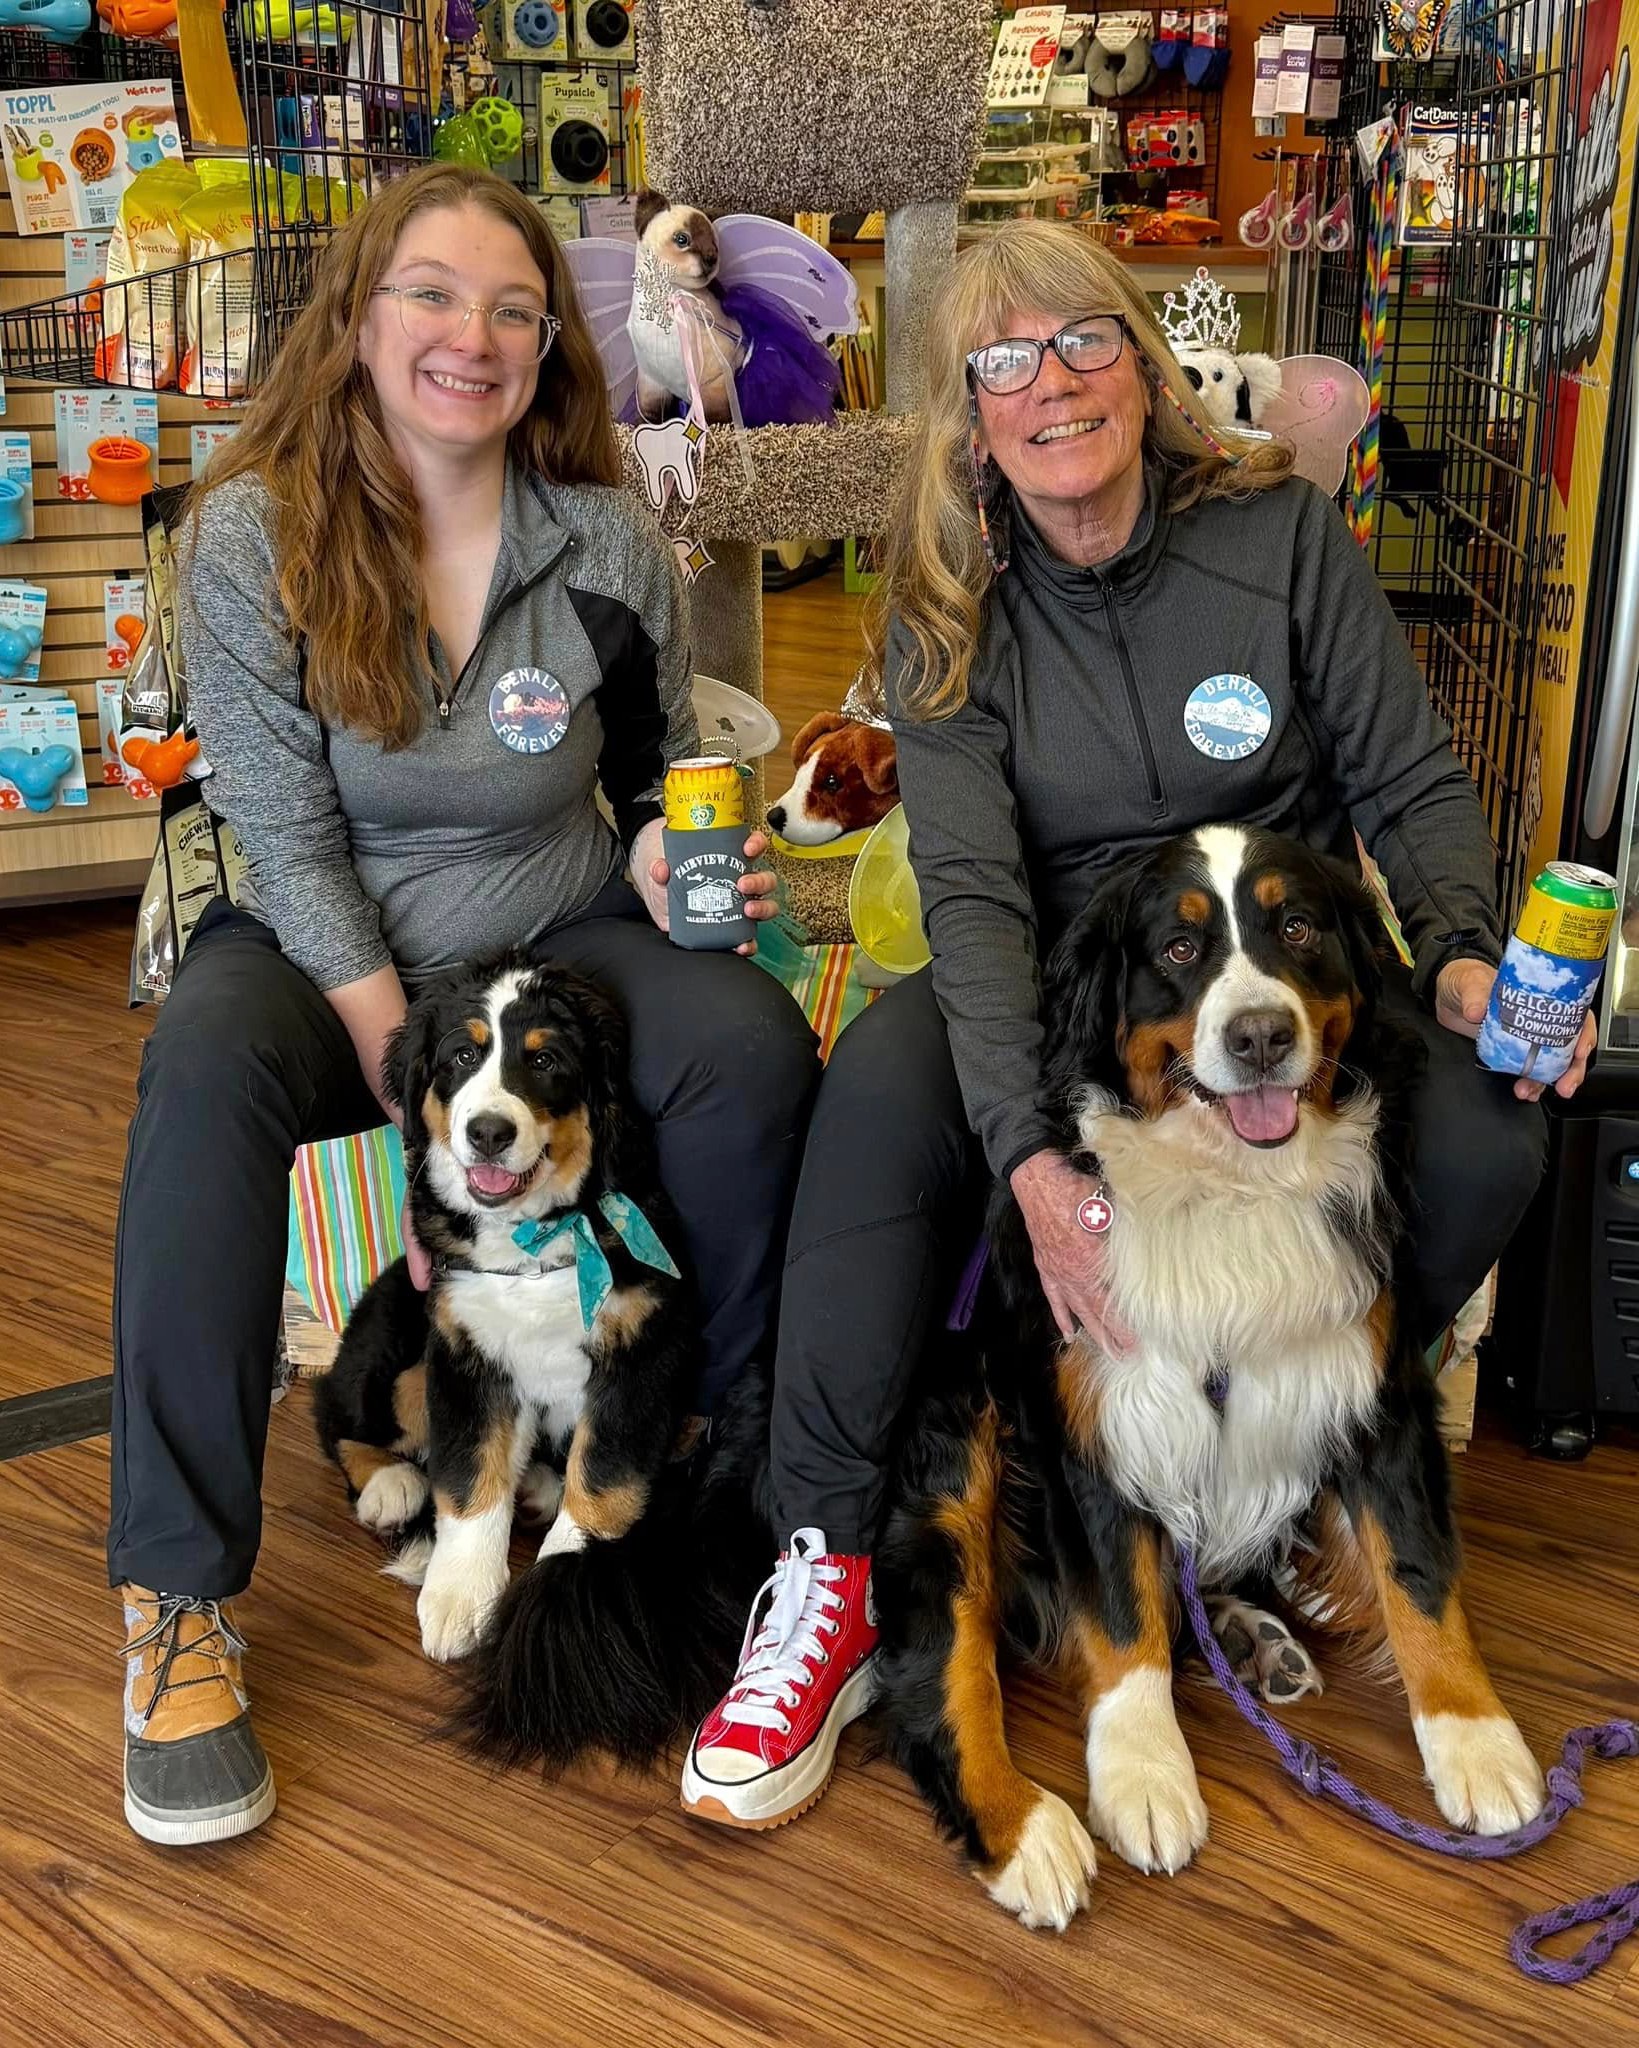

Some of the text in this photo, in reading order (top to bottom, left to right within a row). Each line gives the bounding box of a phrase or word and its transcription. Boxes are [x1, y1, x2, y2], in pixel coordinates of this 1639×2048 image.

[1026, 9, 1052, 18] Catalog
[124, 86, 149, 96] West
[555, 88, 596, 98] Pupsicle
[5, 94, 56, 115] TOPPL
[135, 242, 159, 253] Sweet
[1538, 644, 1569, 687] MEAL!
[1202, 676, 1268, 707] DENALI
[497, 722, 568, 753] FOREVER
[1188, 722, 1262, 759] FOREVER
[677, 791, 726, 804] GUAYAKI
[674, 854, 747, 880] FAIRVIEW INN
[1502, 984, 1584, 1015] WELCOME
[1518, 1006, 1582, 1024] BEAUTIFUL
[1508, 1028, 1565, 1046] TALKEETNA
